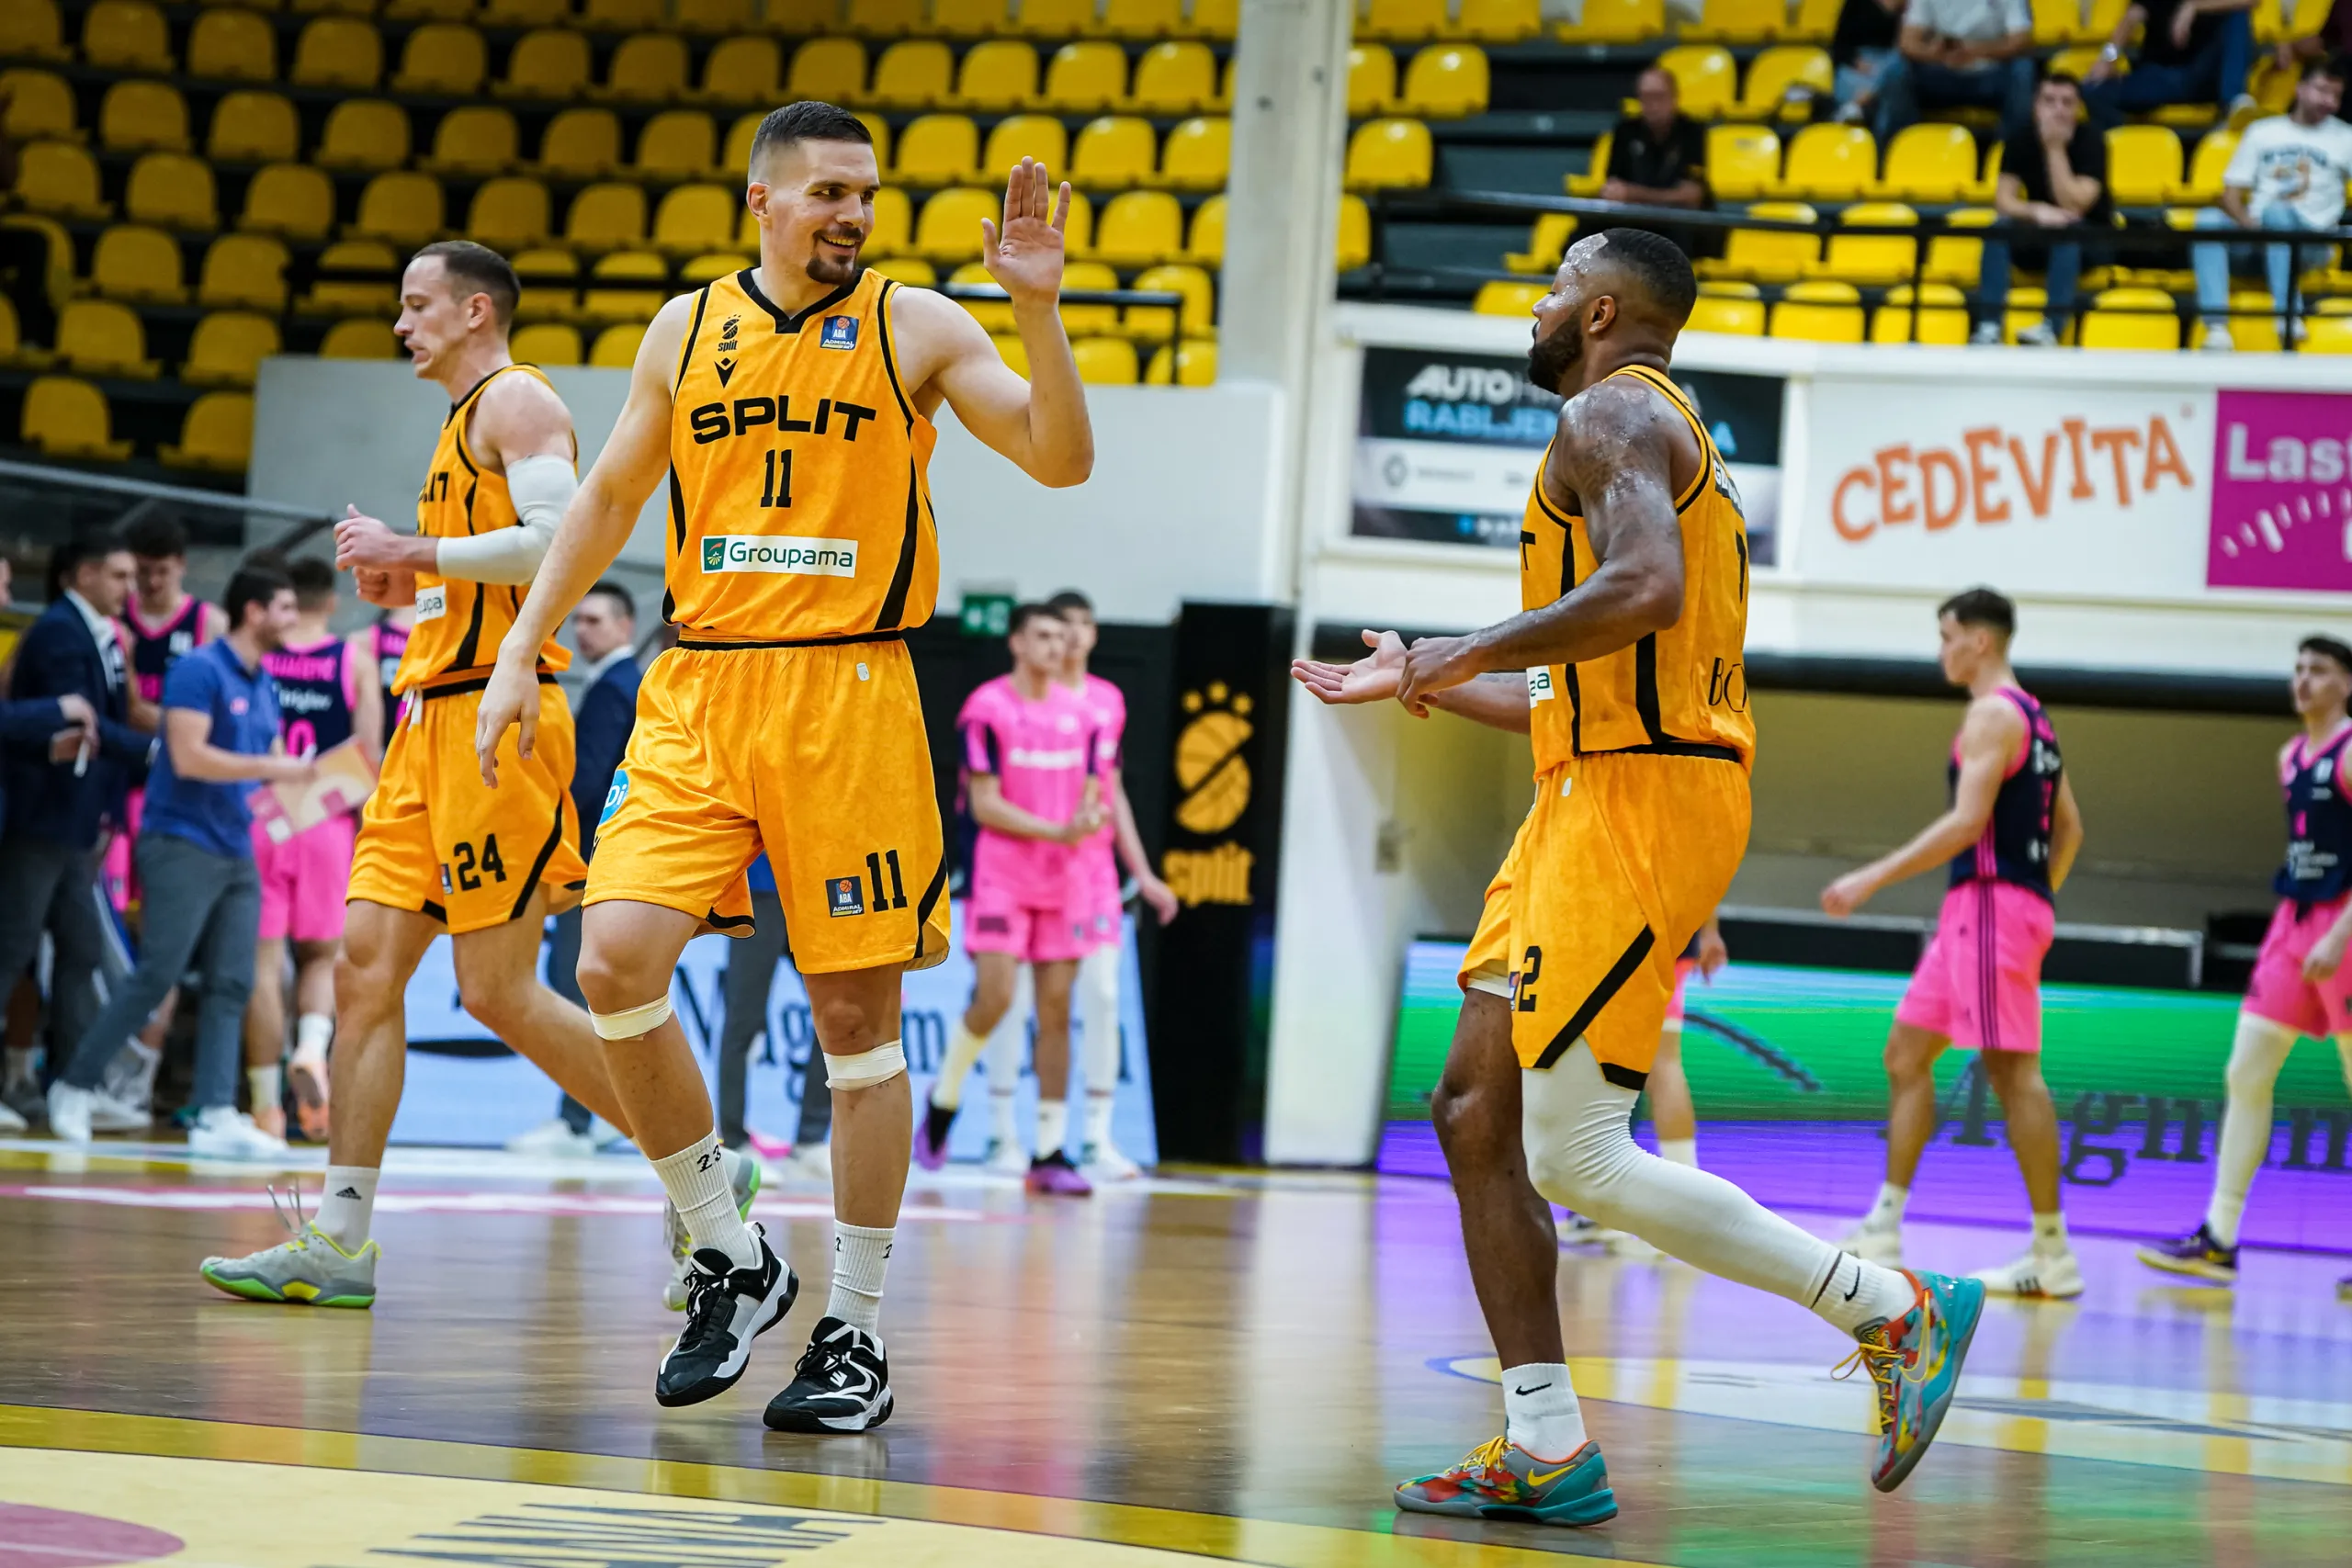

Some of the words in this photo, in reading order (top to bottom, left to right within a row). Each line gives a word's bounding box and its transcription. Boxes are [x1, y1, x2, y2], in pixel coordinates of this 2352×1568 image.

[718, 340, 738, 353] split
[690, 395, 876, 445] SPLIT
[760, 449, 792, 508] 11
[1831, 414, 2195, 543] CEDEVITA
[729, 542, 854, 569] Groupama
[454, 832, 507, 892] 24
[866, 850, 908, 912] 11
[833, 903, 863, 913] ADMIRAL
[839, 893, 853, 904] ABA
[696, 1145, 722, 1173] 23
